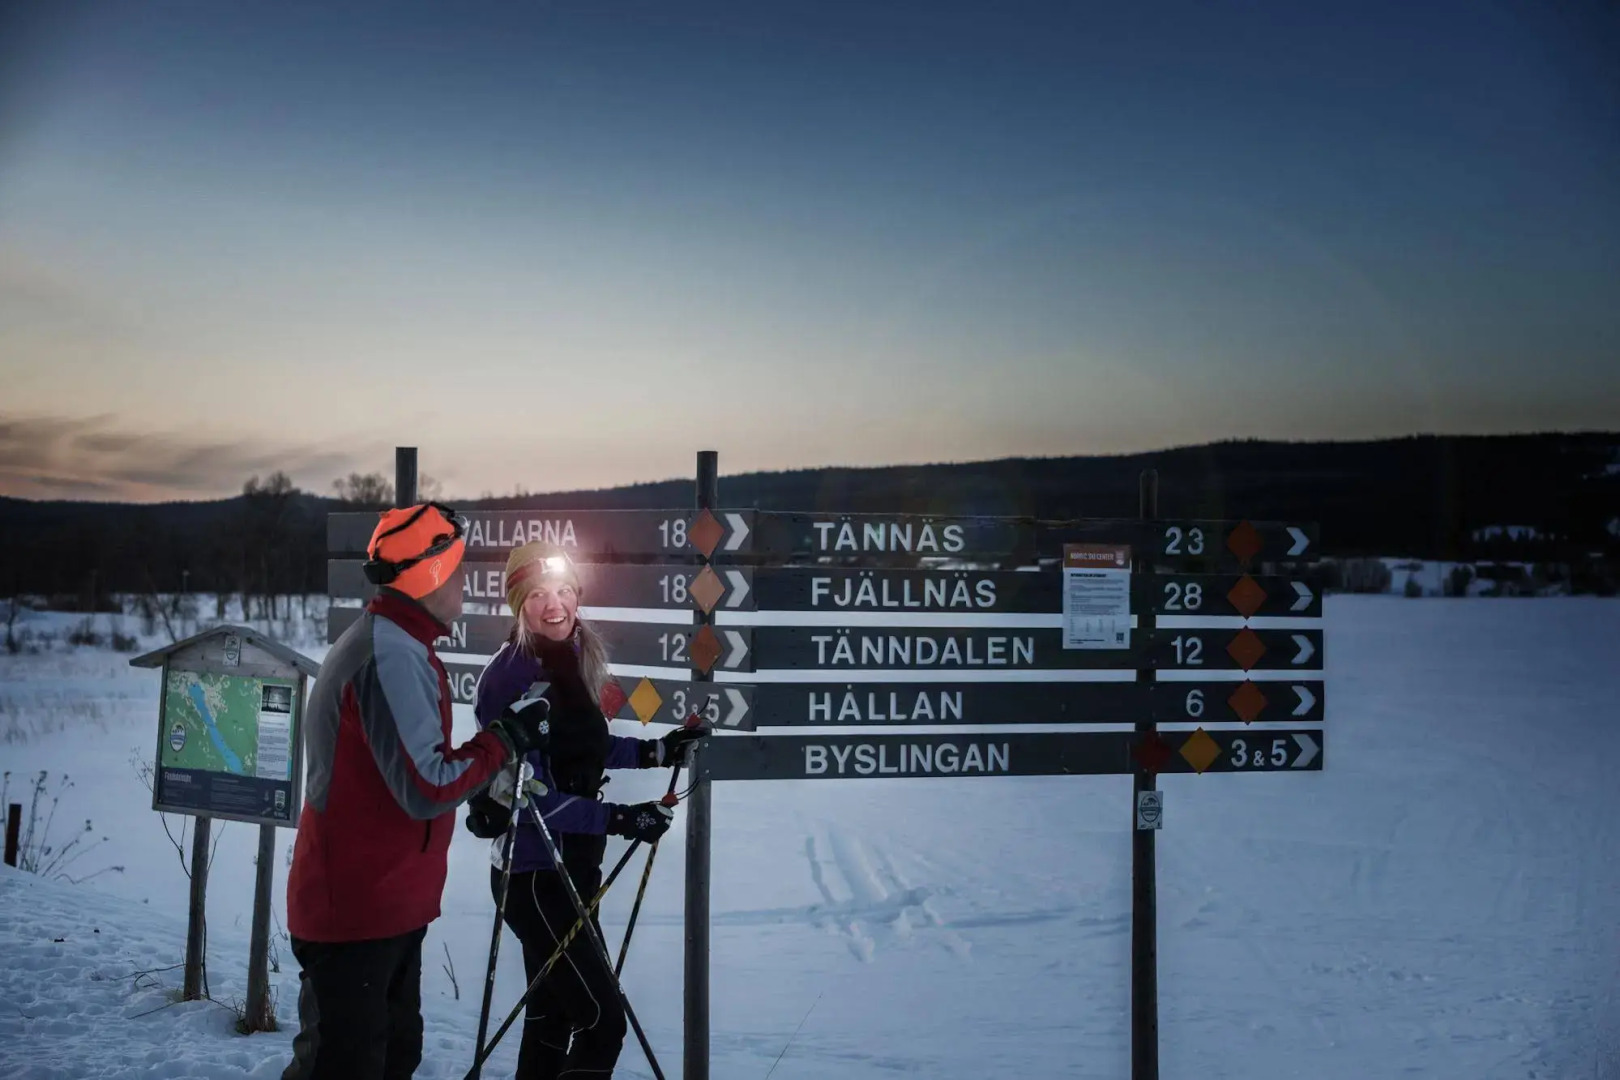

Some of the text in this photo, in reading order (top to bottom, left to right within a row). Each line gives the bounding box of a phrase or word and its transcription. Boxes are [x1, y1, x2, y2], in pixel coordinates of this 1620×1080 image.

[659, 519, 686, 547] 18
[814, 518, 964, 551] TÄNNÄS
[1166, 527, 1203, 554] 23
[660, 574, 686, 602] 18
[812, 572, 996, 607] FJÄLLNÄS
[1165, 582, 1201, 610] 28
[659, 634, 685, 661] 12
[812, 629, 1034, 664] TÄNNDALEN
[1171, 636, 1202, 664] 12
[808, 684, 961, 720] HÅLLAN
[1186, 690, 1203, 716] 6
[806, 743, 1008, 774] BYSLINGAN
